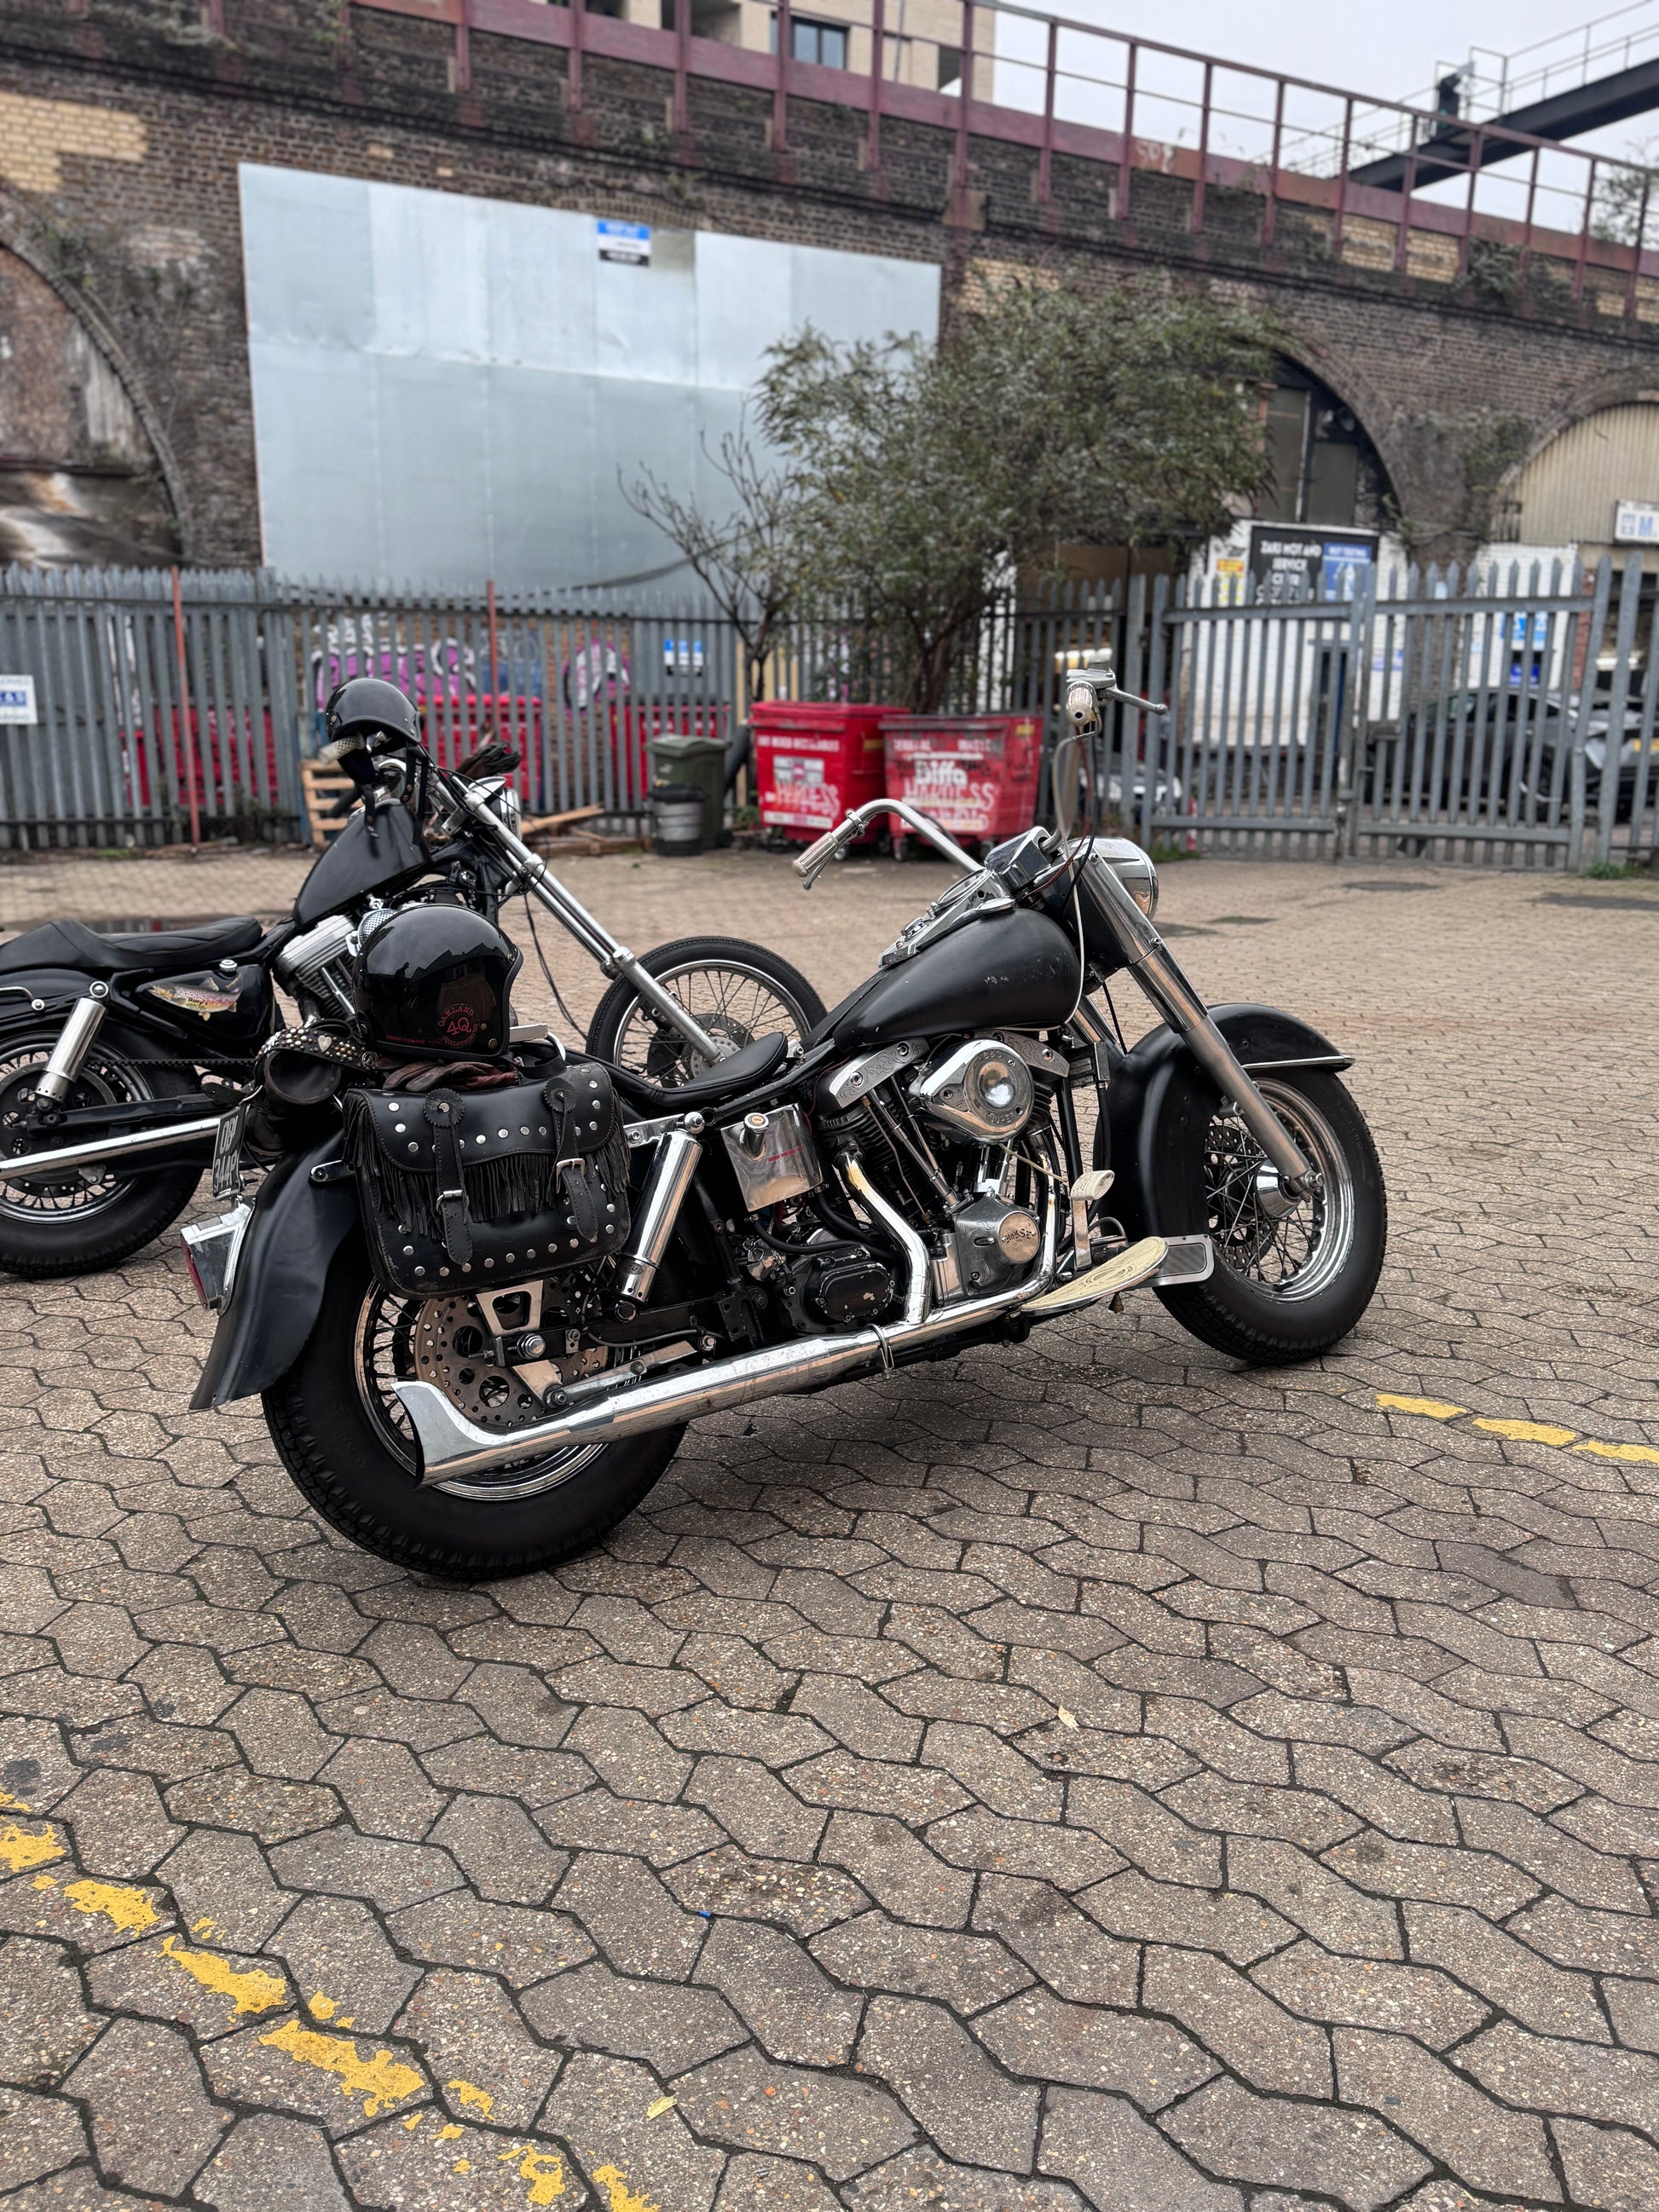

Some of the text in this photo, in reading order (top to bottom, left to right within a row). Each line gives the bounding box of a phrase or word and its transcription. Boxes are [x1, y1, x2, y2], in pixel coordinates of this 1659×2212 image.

[915, 759, 968, 787] Biffa
[437, 1006, 475, 1027] OAKLAND
[446, 1017, 471, 1036] 4Q
[442, 1024, 478, 1047] CONDITIONING
